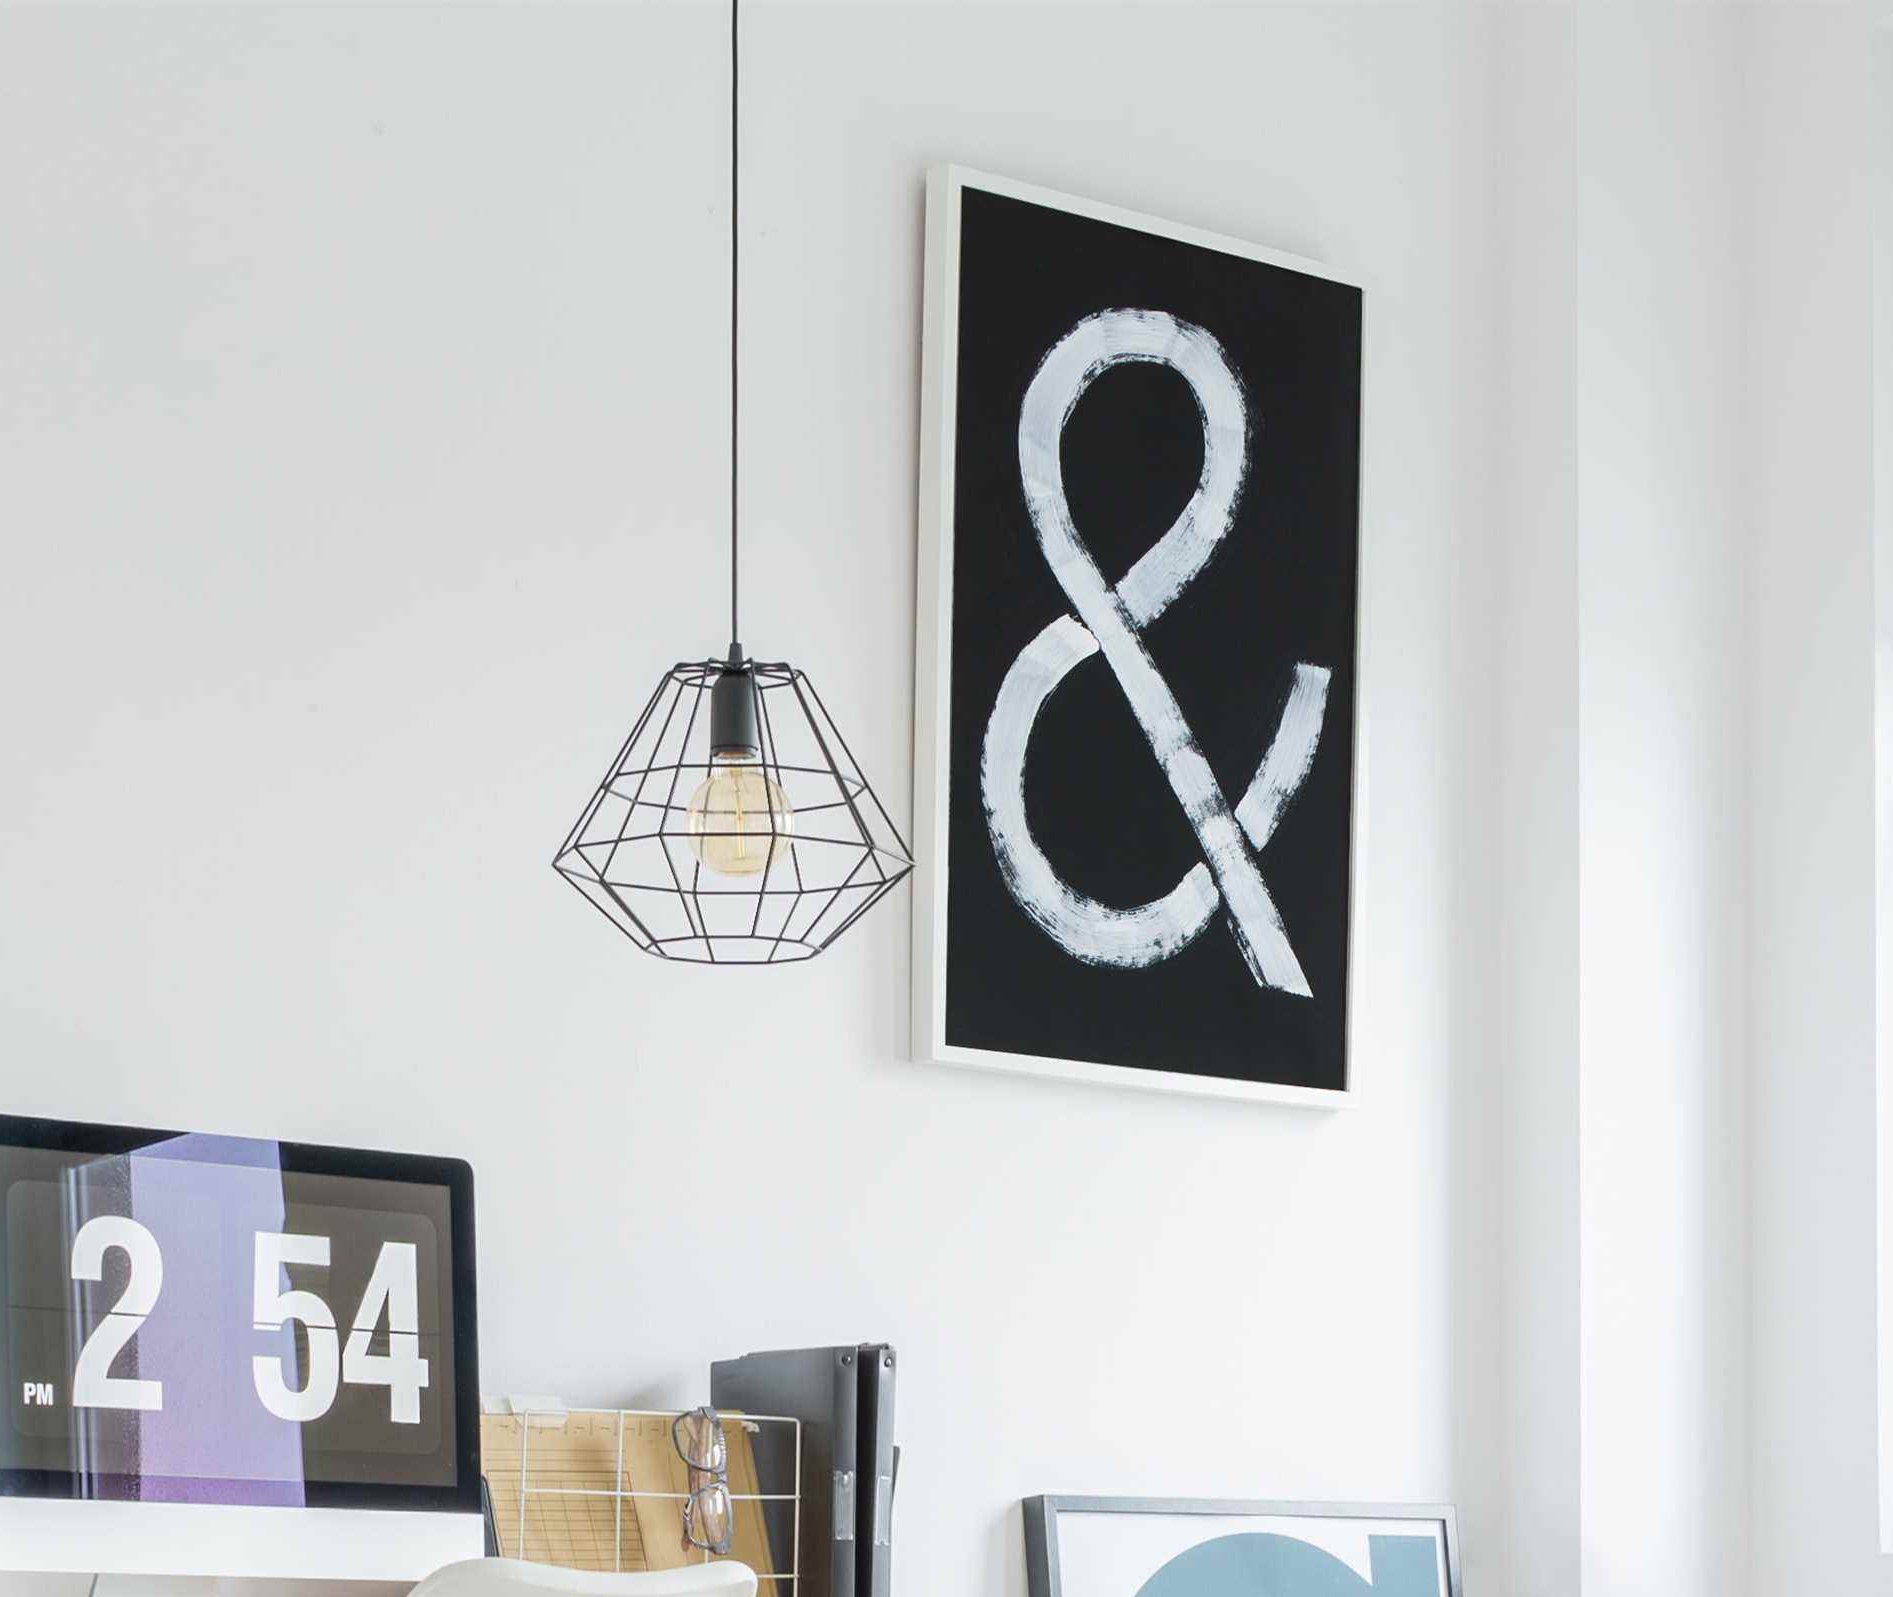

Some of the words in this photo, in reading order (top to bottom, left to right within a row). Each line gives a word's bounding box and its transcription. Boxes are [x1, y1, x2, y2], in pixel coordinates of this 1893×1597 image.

[979, 307, 1333, 999] &
[23, 1381, 54, 1407] PM
[70, 1214, 163, 1411] 2
[251, 1230, 430, 1425] 54
